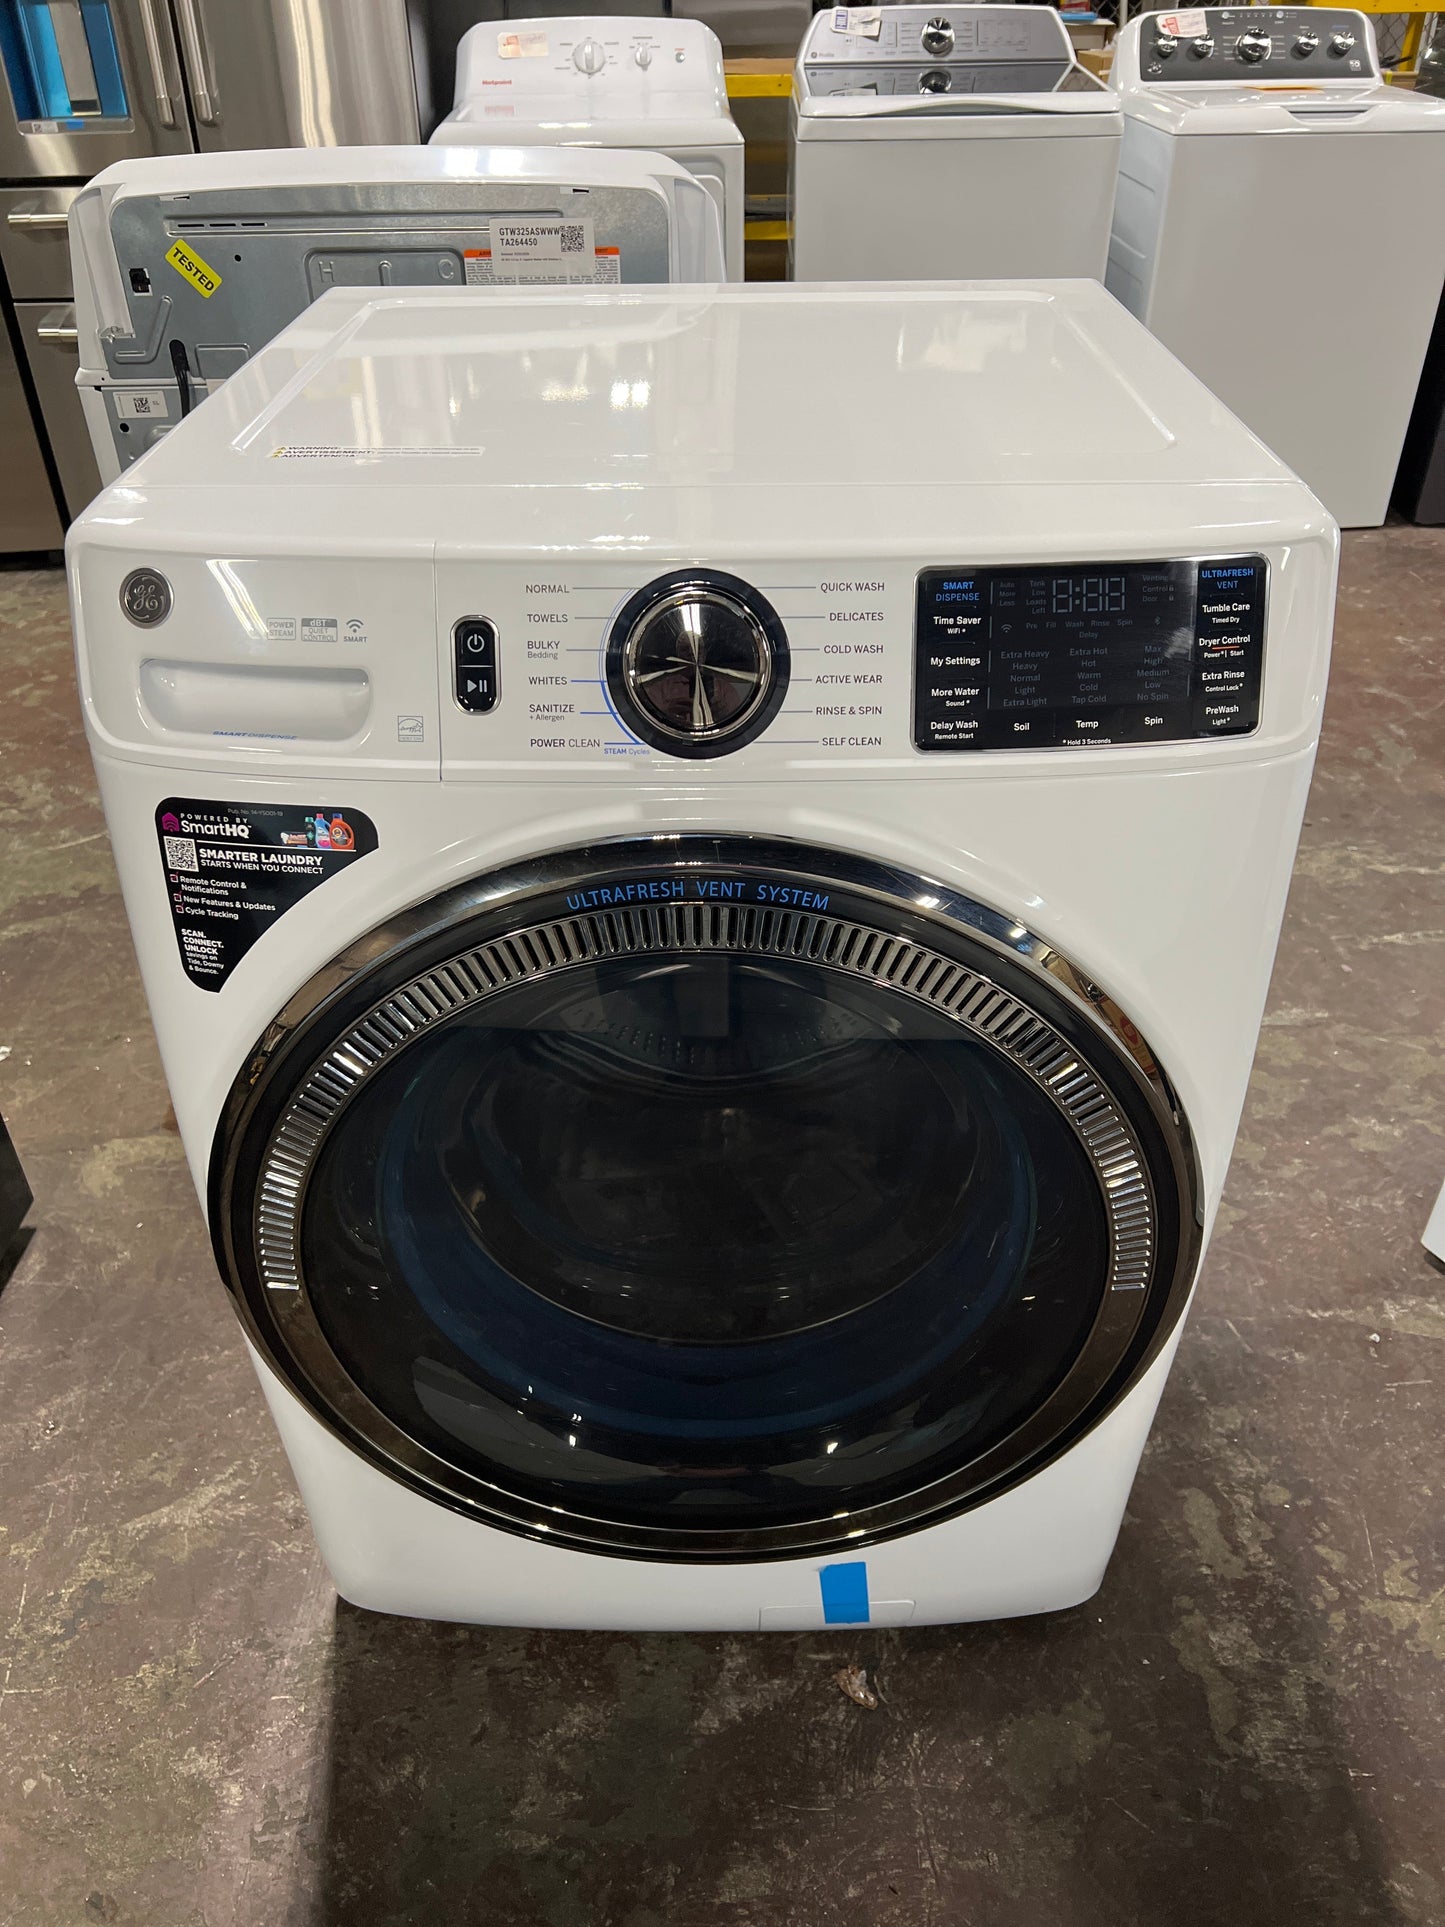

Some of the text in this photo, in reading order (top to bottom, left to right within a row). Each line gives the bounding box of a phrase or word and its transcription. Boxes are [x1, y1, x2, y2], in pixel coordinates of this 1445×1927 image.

[499, 227, 559, 236] GTW325ASWWW
[500, 238, 538, 246] TA264450
[172, 247, 214, 292] TESTED
[1202, 568, 1254, 578] ULTRAFRESH
[525, 584, 570, 593] NORMAL
[820, 582, 885, 593] QUICK WASH
[943, 581, 974, 590] SMART
[1217, 581, 1238, 589] VENT
[936, 593, 980, 601] DISPENSE
[1202, 603, 1251, 613] Tumble Care
[527, 614, 568, 623] TOWELS
[829, 612, 884, 621] DELICATES
[933, 616, 982, 625] Time Saver
[1230, 616, 1240, 624] Dry
[527, 640, 561, 649] BULKY
[1199, 635, 1251, 647] Dryer Control
[824, 645, 884, 653] COLD WASH
[527, 651, 558, 660] Bedding
[1000, 650, 1050, 659] Extra Heavy
[930, 656, 981, 666] My Settings
[1012, 663, 1038, 671] Heavy
[1010, 674, 1040, 682] Normal
[1136, 669, 1170, 678] Medium
[1202, 671, 1245, 681] Extra Rinse
[529, 677, 567, 685] WHITES
[815, 675, 883, 684] ACTIVE WEAR
[1080, 683, 1098, 691] Cold
[1145, 681, 1161, 689] Low
[931, 688, 980, 697] More Water
[1015, 687, 1036, 695] Light
[1071, 695, 1107, 704] Tap Cold
[1150, 692, 1169, 702] Spin
[1003, 698, 1047, 707] Extra Light
[529, 704, 575, 713] SANITIZE
[816, 706, 882, 715] RINSE & SPIN
[1206, 705, 1239, 715] PreWash
[535, 714, 565, 722] Allergen
[1144, 717, 1163, 726] Spin
[930, 721, 979, 731] Delay Wash
[1013, 722, 1030, 731] Soil
[1075, 720, 1099, 729] Temp
[530, 739, 600, 748] POWER CLEAN
[822, 737, 882, 746] SELF CLEAN
[628, 748, 650, 756] Cycles
[180, 813, 229, 823] POWERED
[199, 848, 323, 866] SMARTER LAUNDRY
[200, 859, 324, 874] STARTS WHEN YOU CONNECT
[179, 875, 209, 886] Remote
[210, 879, 239, 889] Control
[181, 884, 229, 896] Notifications
[566, 881, 829, 911] ULTRAFRESH VENT SYSTEM
[183, 895, 199, 904] New
[200, 897, 234, 908] Features
[242, 901, 276, 911] Updates
[185, 907, 239, 920] Cycle Tracking
[181, 928, 207, 938] SCAN.
[183, 936, 224, 948] CONNECT.
[184, 944, 219, 955] UNLOCK
